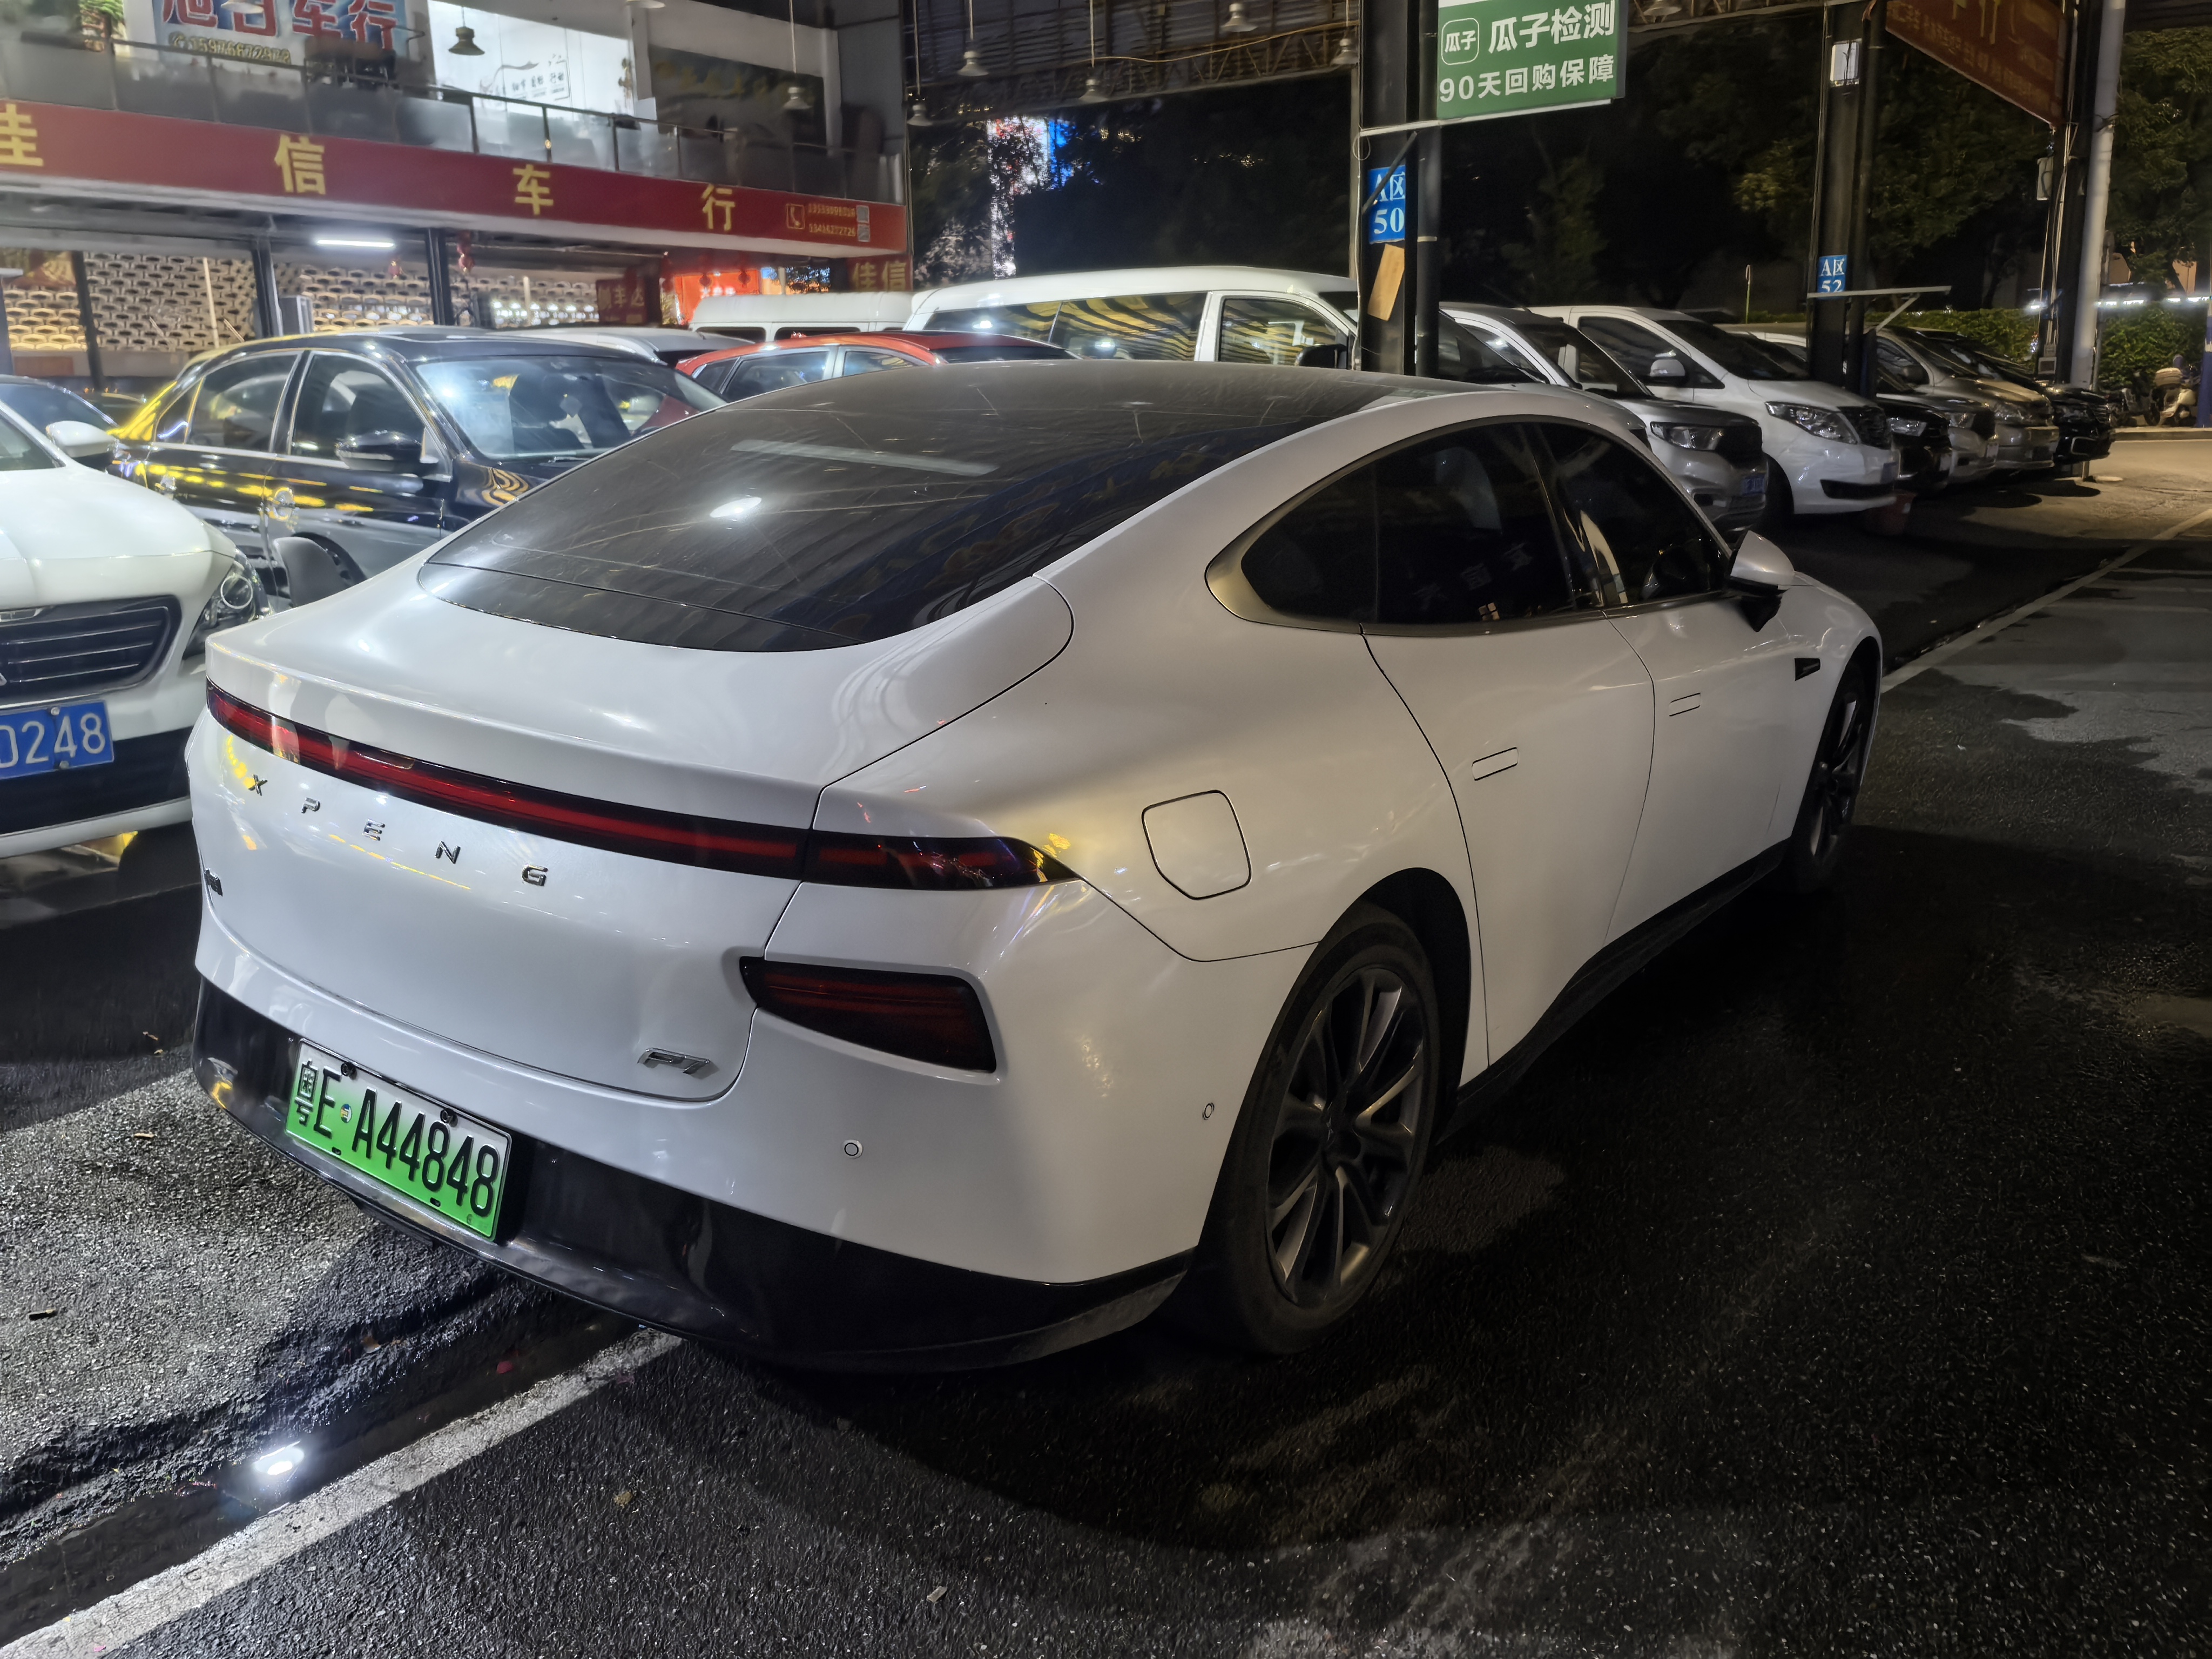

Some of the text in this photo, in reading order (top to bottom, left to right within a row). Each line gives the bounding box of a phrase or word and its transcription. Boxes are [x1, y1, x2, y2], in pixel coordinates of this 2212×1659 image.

[1488, 0, 1615, 53] 瓜子检测
[1445, 30, 1476, 53] 瓜子
[1439, 54, 1614, 102] 90天回购保障
[1374, 207, 1404, 234] 50
[1820, 258, 1845, 277] A区
[1822, 279, 1842, 293] 52
